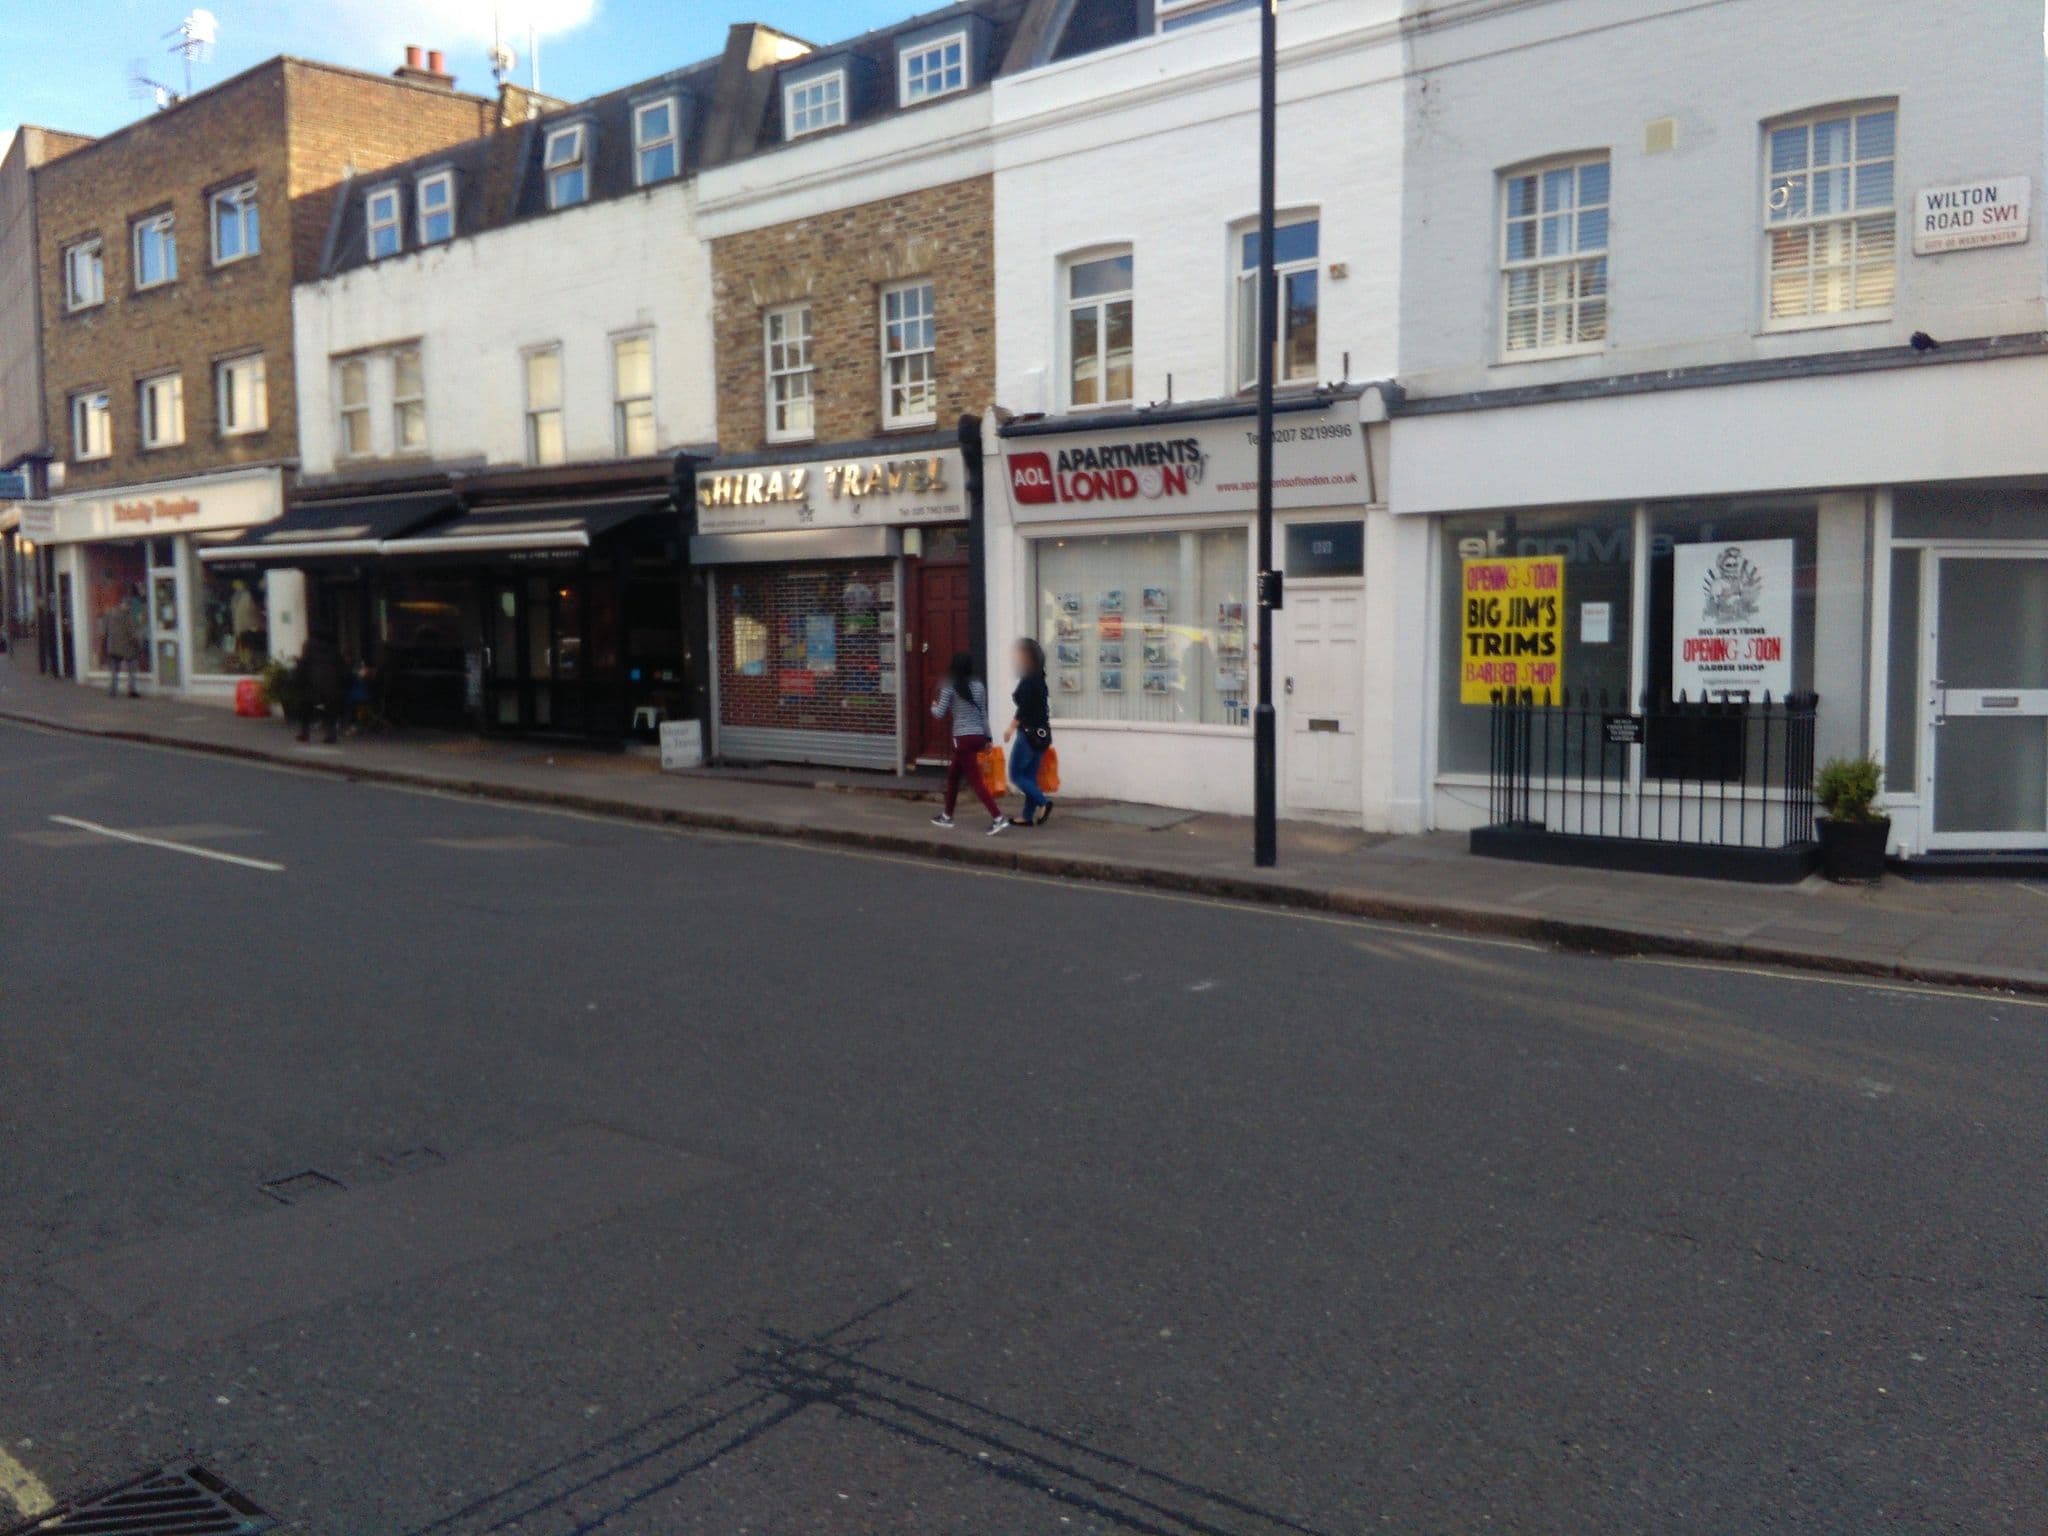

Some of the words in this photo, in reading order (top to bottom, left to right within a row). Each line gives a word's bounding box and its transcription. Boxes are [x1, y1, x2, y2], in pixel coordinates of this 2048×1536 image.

[1926, 187, 1997, 210] WILTON
[1926, 210, 1973, 231] ROAD
[1983, 204, 2018, 224] SW1
[1300, 424, 1353, 441] 8219996
[1057, 438, 1200, 471] APARTMENTS
[699, 466, 808, 506] SHIRAZ
[823, 456, 946, 500] TRAVEL
[1014, 467, 1050, 487] AOL
[1057, 463, 1188, 501] LONDON
[1467, 565, 1518, 592] OPENING
[1523, 563, 1558, 588] SOON
[1468, 598, 1501, 628] BIG
[1506, 596, 1556, 627] JIM'S
[1467, 632, 1556, 656] TRIMS
[1682, 637, 1738, 662] OPENING
[1743, 637, 1781, 661] SOON
[1466, 661, 1517, 685] BARBER
[1521, 661, 1556, 685] SHOP
